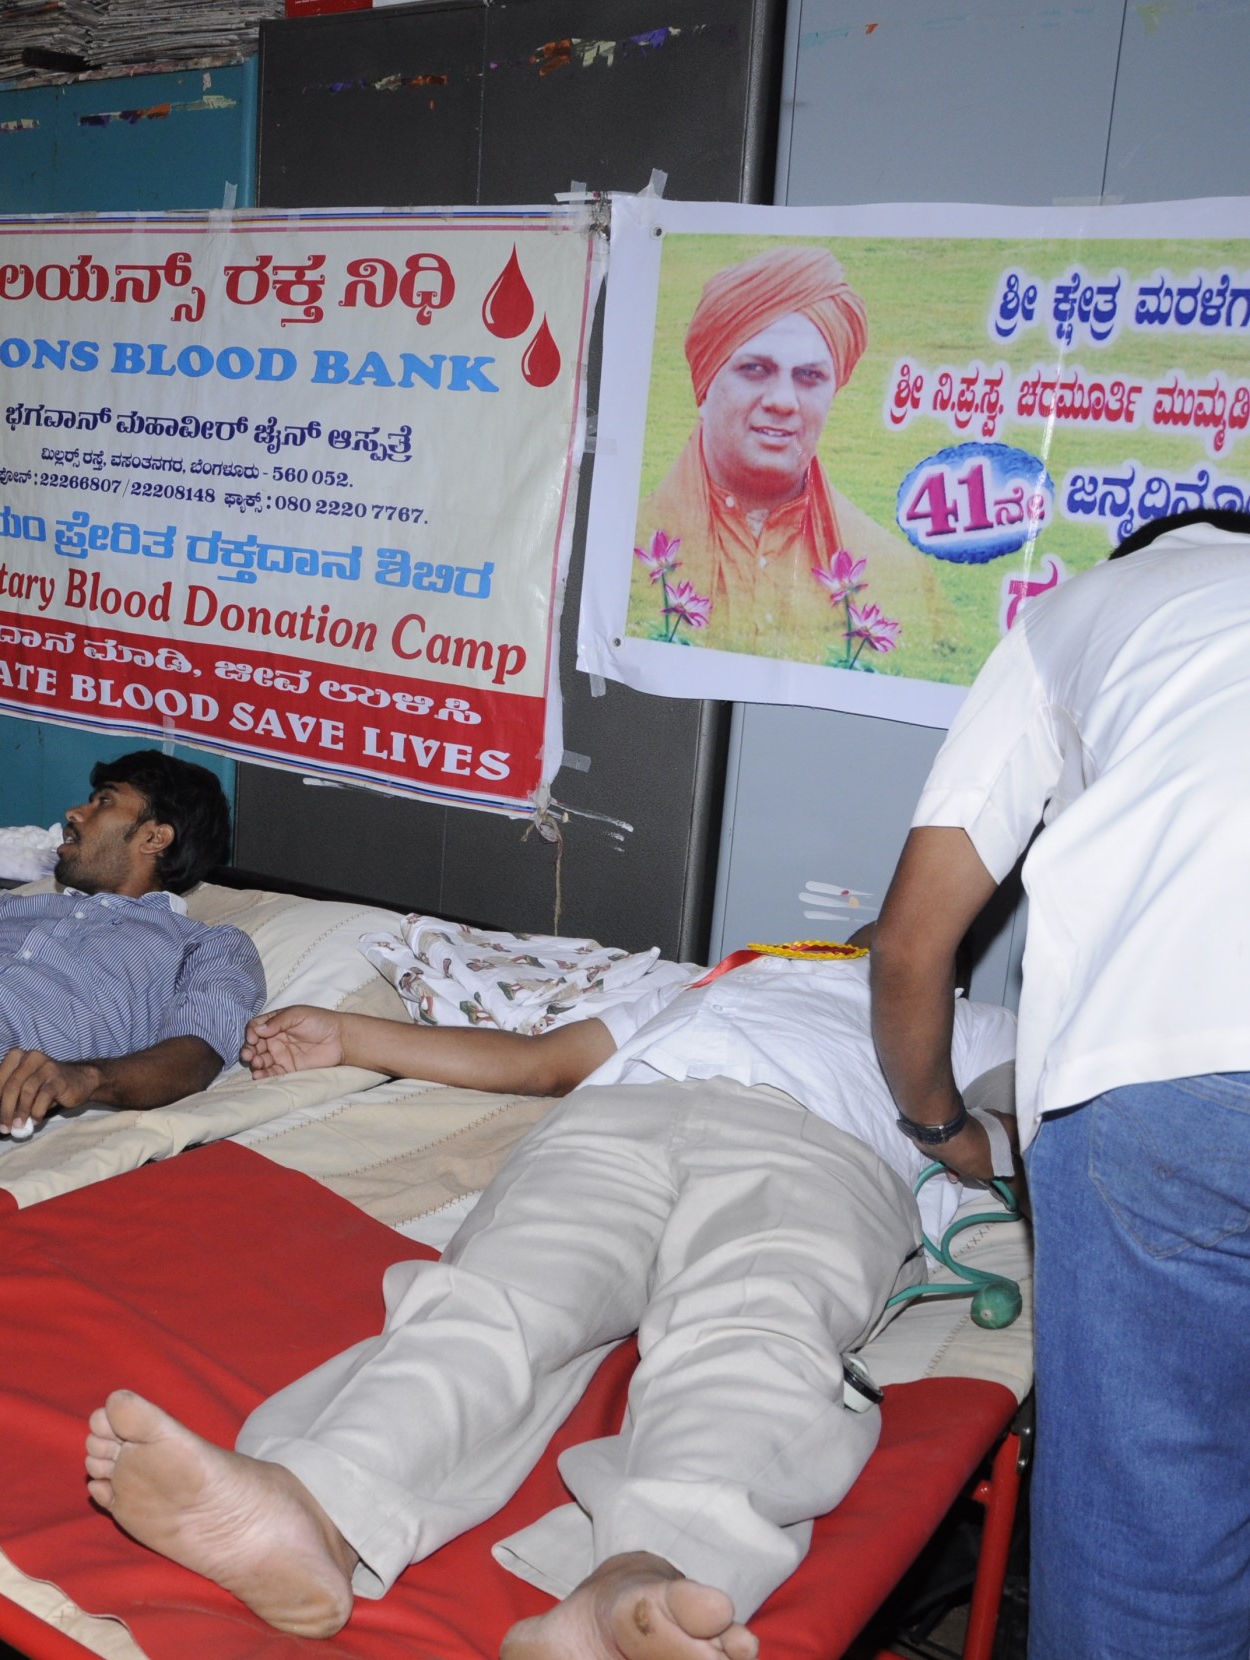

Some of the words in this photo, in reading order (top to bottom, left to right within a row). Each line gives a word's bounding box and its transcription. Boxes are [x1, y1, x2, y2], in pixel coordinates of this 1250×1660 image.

[223, 252, 328, 328] ರಕ್ತ
[338, 249, 458, 326] ನಿಧಿ
[994, 273, 1038, 338] ಶ್ರೀ
[1052, 272, 1121, 346] ಕ್ಷೇತ್ರ
[111, 343, 297, 385] BLOOD
[310, 348, 500, 394] BANK
[890, 364, 924, 425] ಶ್ರೀ
[5, 403, 112, 431] ಭಗವಾನ್
[116, 411, 249, 441] ಮಹಾವೀರ್
[253, 416, 321, 454] ಜೈನ್
[272, 466, 308, 484] 560
[312, 470, 353, 488] 052.
[275, 495, 311, 512] 080
[315, 499, 367, 518] 2220
[371, 504, 429, 525] 7767.
[54, 511, 177, 560] ಪ್ರೇರಿತ
[185, 530, 363, 584] ರಕ್ತದಾನ
[375, 547, 495, 599] ಶಿಬಿರ
[64, 568, 173, 622] Blood
[183, 585, 378, 652] Donation
[391, 613, 527, 685] Camp
[83, 638, 202, 676] ಮಾಡಿ,
[214, 660, 313, 694] ಜೀವ
[70, 674, 220, 722] BLOOD
[228, 701, 345, 751] SAVE
[362, 726, 511, 781] LIVES
